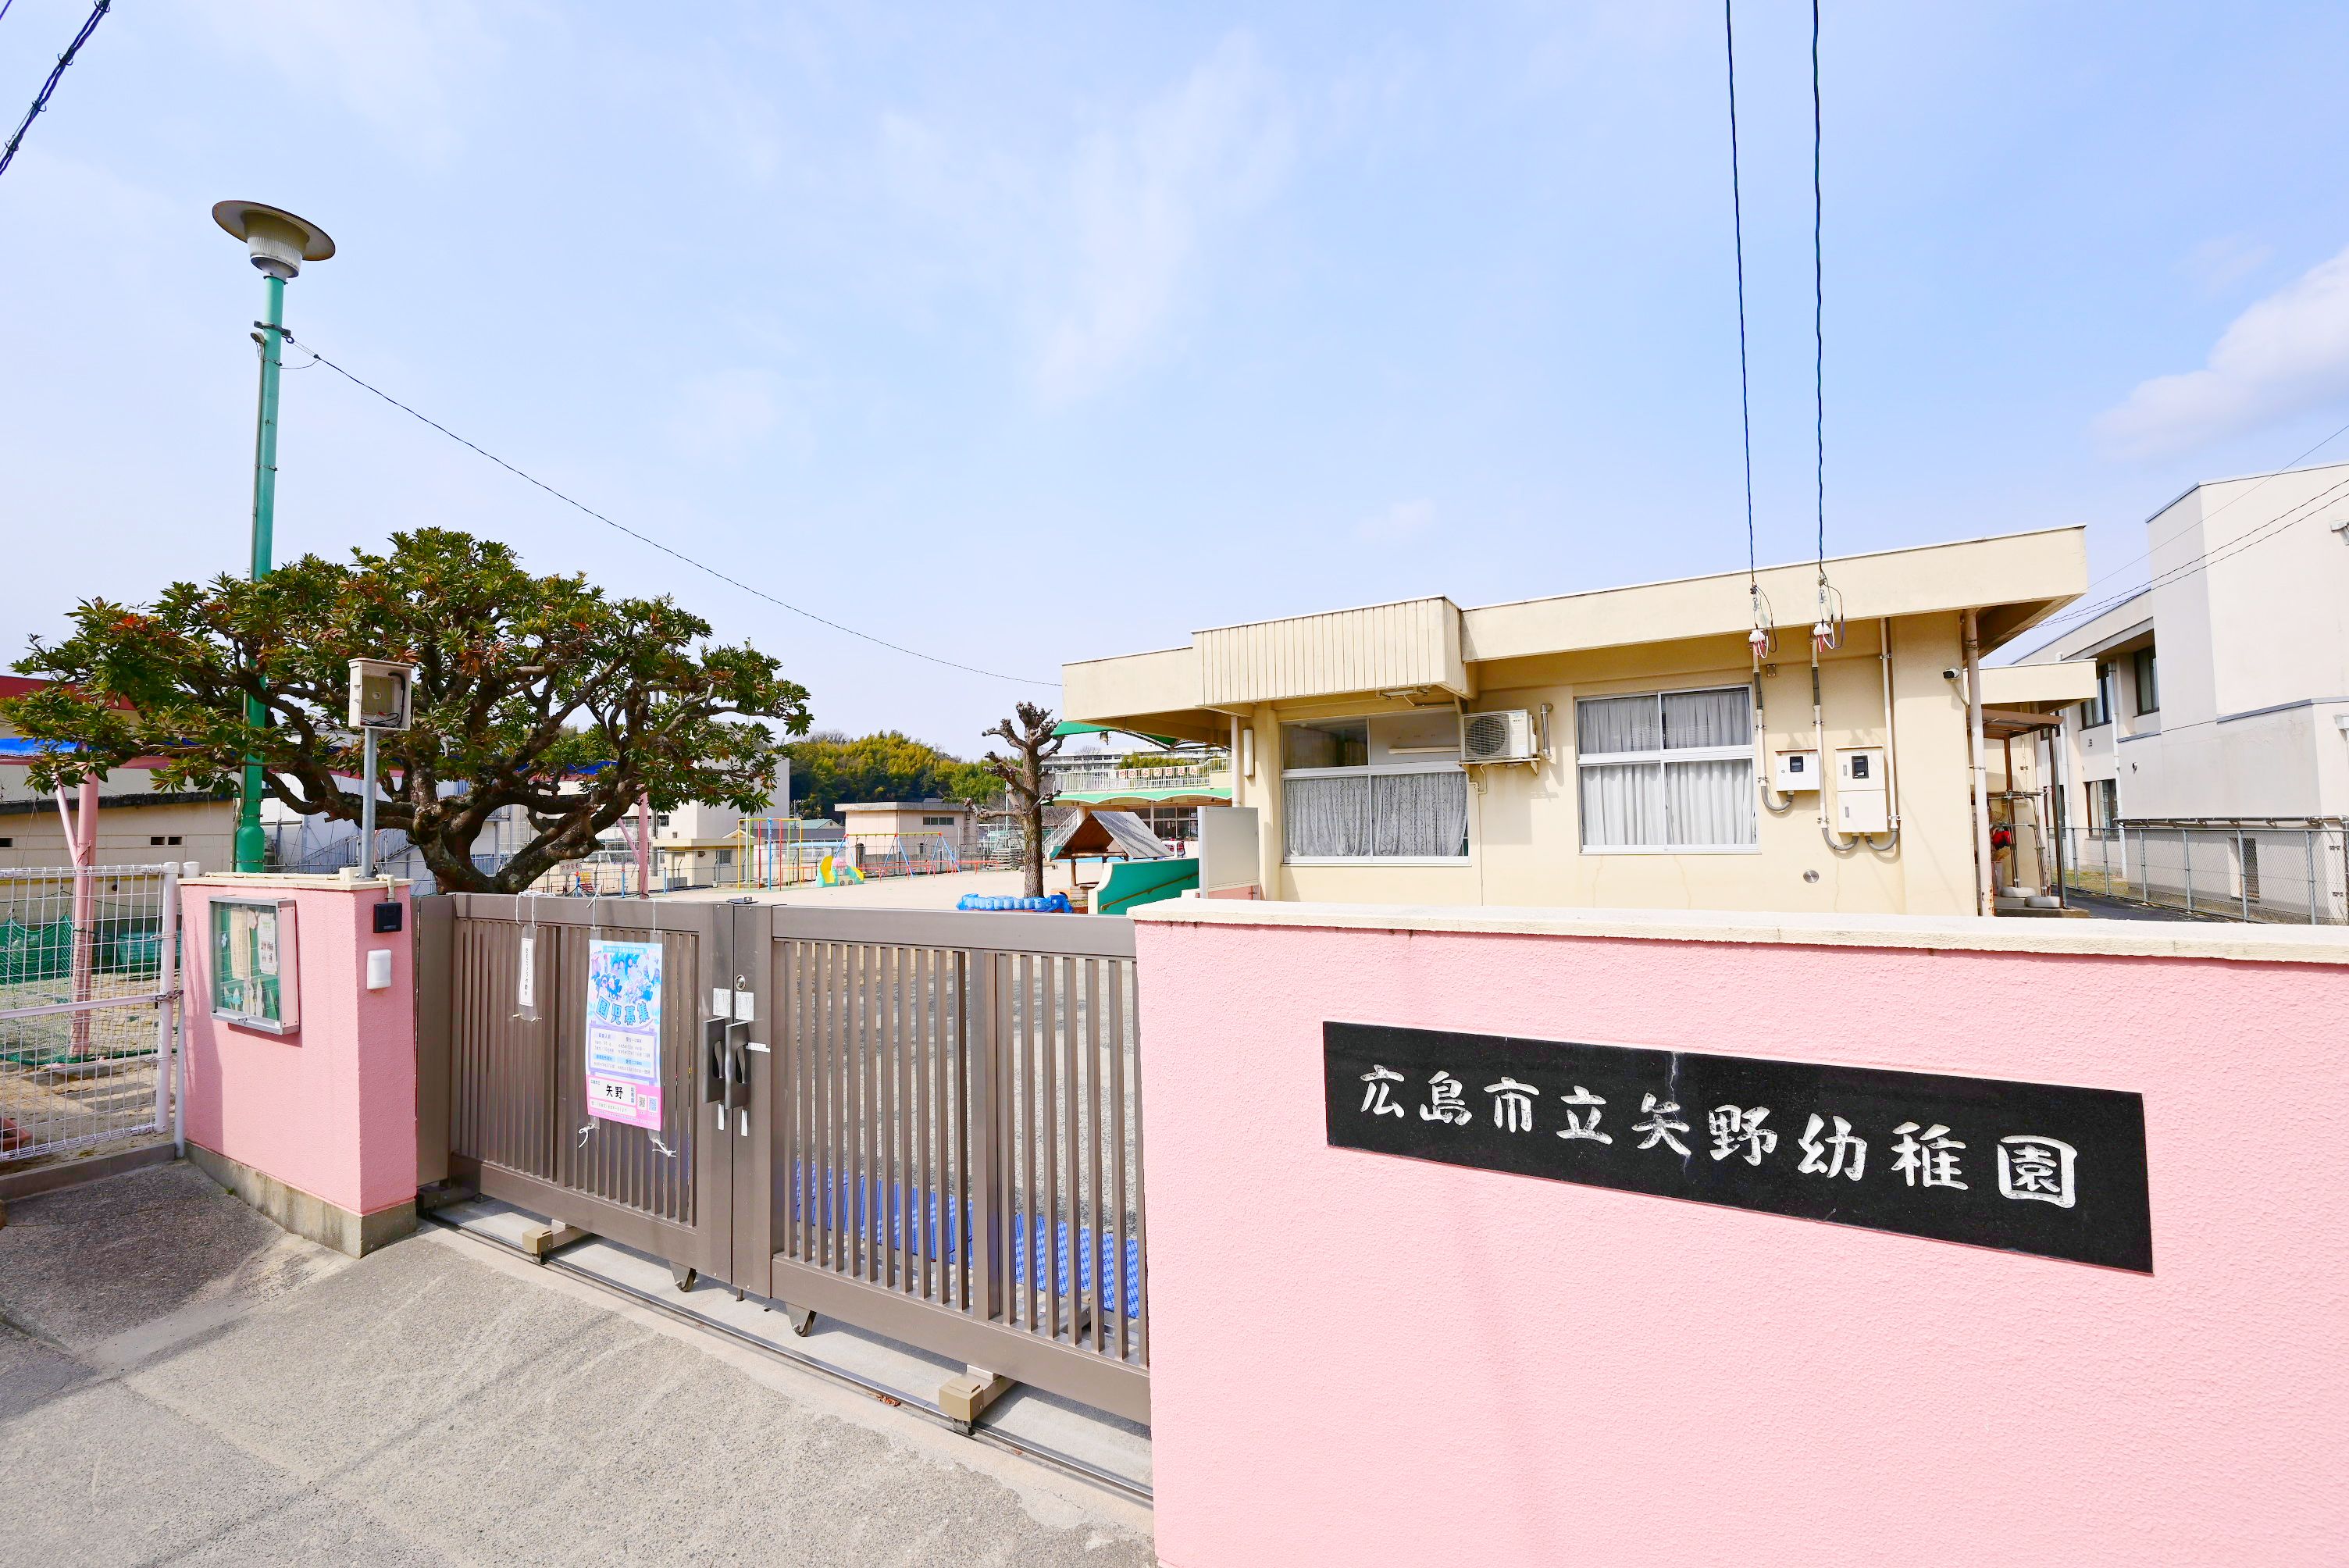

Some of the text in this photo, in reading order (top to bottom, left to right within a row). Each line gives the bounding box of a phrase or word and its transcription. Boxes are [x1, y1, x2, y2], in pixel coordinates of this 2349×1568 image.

[1119, 768, 1197, 777] やのようちえん
[596, 996, 651, 1026] 園児募集
[605, 1084, 623, 1099] 矢野
[1360, 1064, 2077, 1209] 広島市立矢野幼稚園
